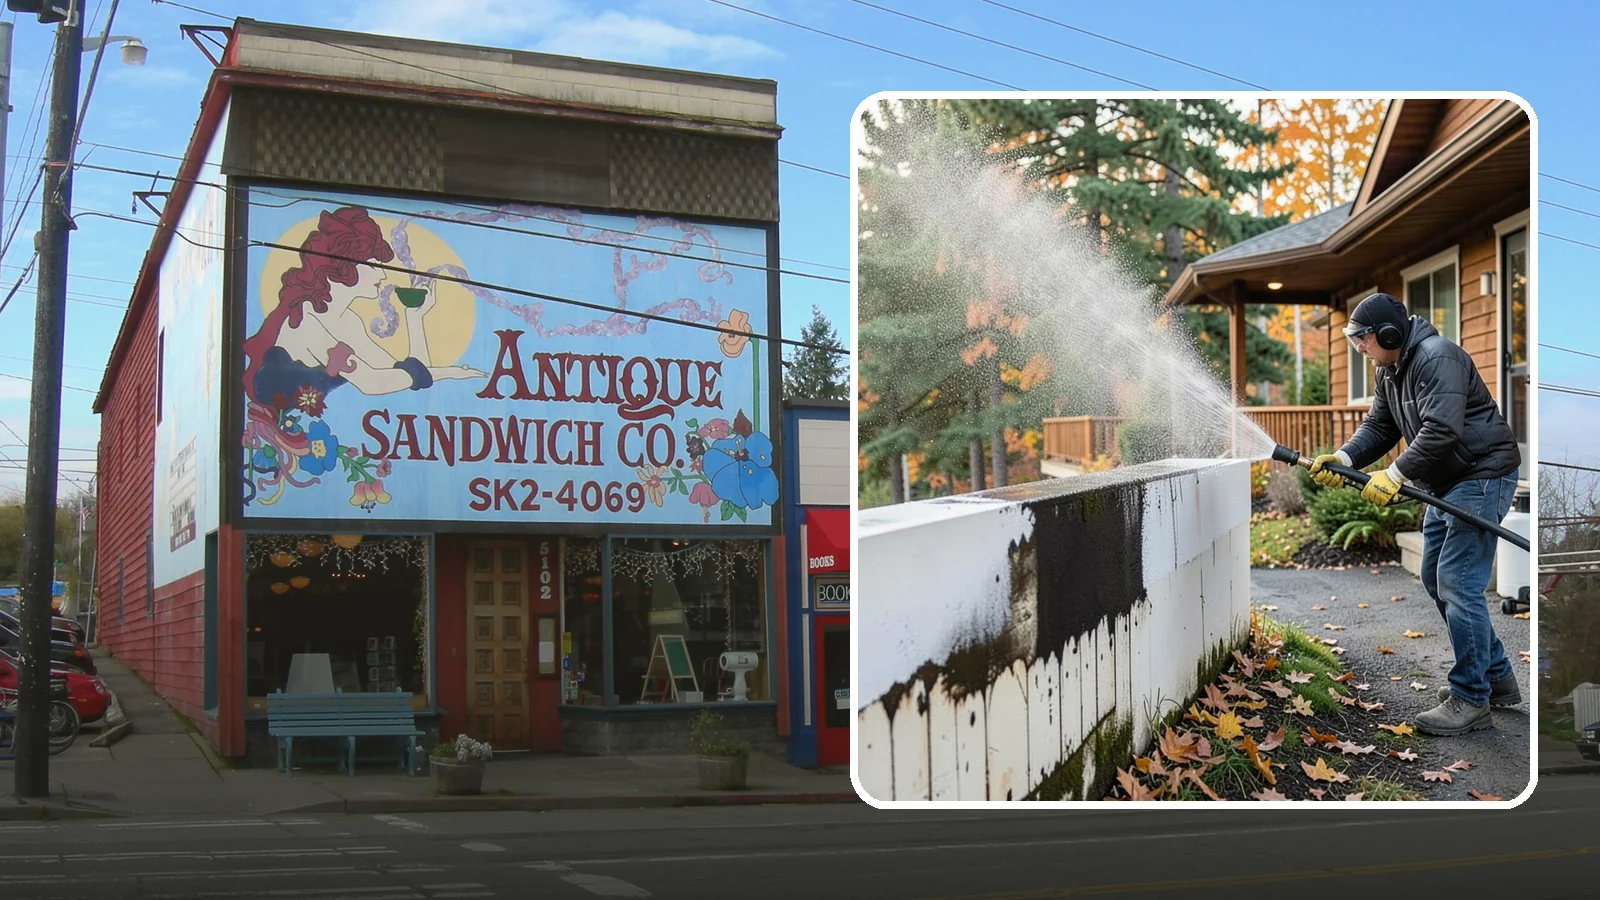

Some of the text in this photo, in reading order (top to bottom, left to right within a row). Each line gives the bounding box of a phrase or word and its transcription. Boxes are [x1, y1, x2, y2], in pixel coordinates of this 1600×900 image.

[476, 329, 724, 421] ANTIQUE
[361, 408, 684, 468] SANDWICH CO.
[468, 478, 646, 513] SK2-4069
[540, 542, 552, 599] 5102
[809, 555, 835, 569] BOOKS
